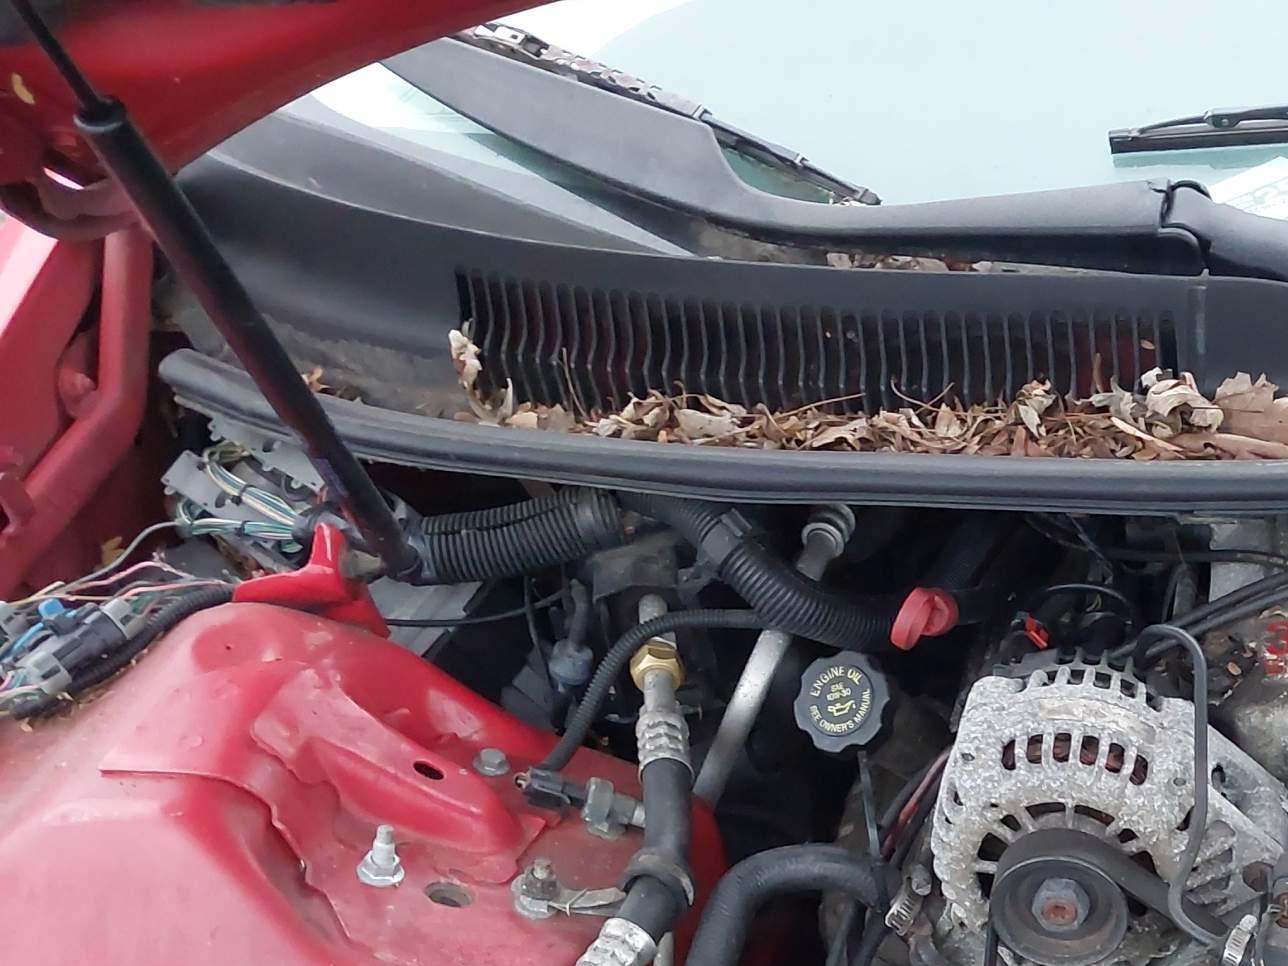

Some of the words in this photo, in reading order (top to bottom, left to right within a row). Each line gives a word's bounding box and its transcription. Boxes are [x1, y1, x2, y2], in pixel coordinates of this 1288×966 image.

[809, 666, 845, 697] ENGINE
[847, 668, 864, 686] OIL
[819, 719, 855, 733] OWNER'S
[853, 688, 871, 723] MANUAL
